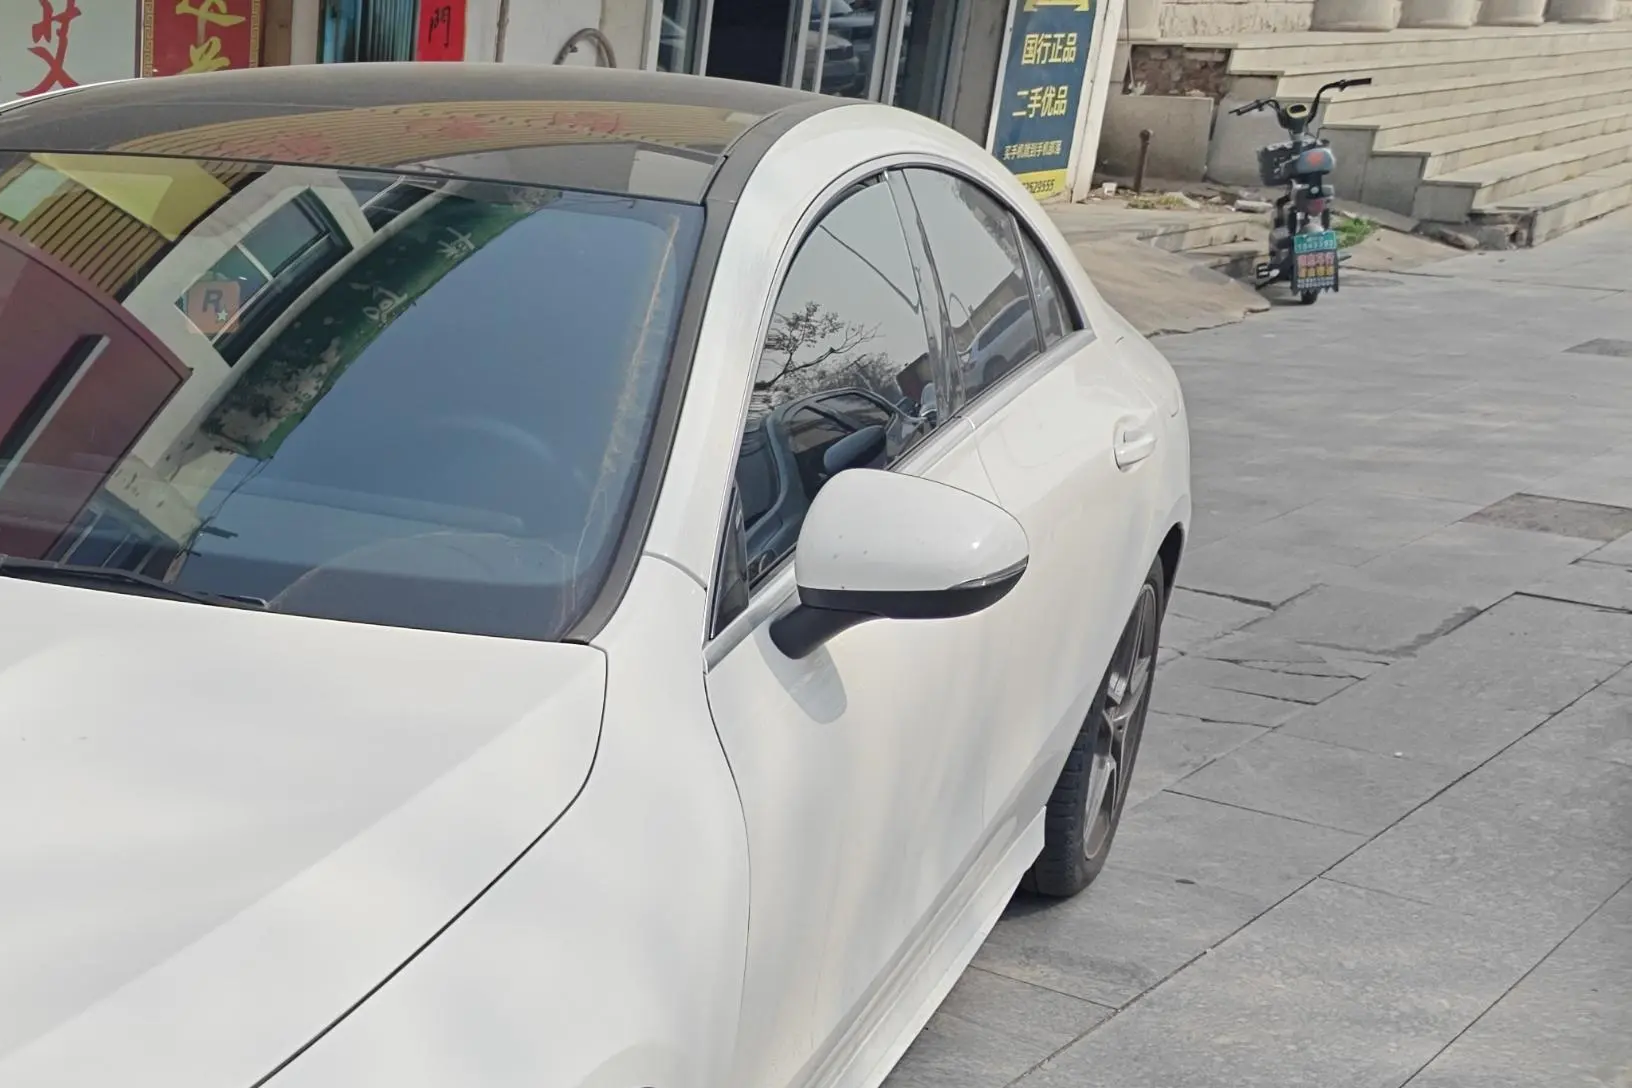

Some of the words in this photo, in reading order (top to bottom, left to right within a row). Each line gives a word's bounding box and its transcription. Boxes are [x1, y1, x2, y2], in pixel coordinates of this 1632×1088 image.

[1021, 32, 1077, 66] 国行正品
[1012, 85, 1068, 118] 二手优品
